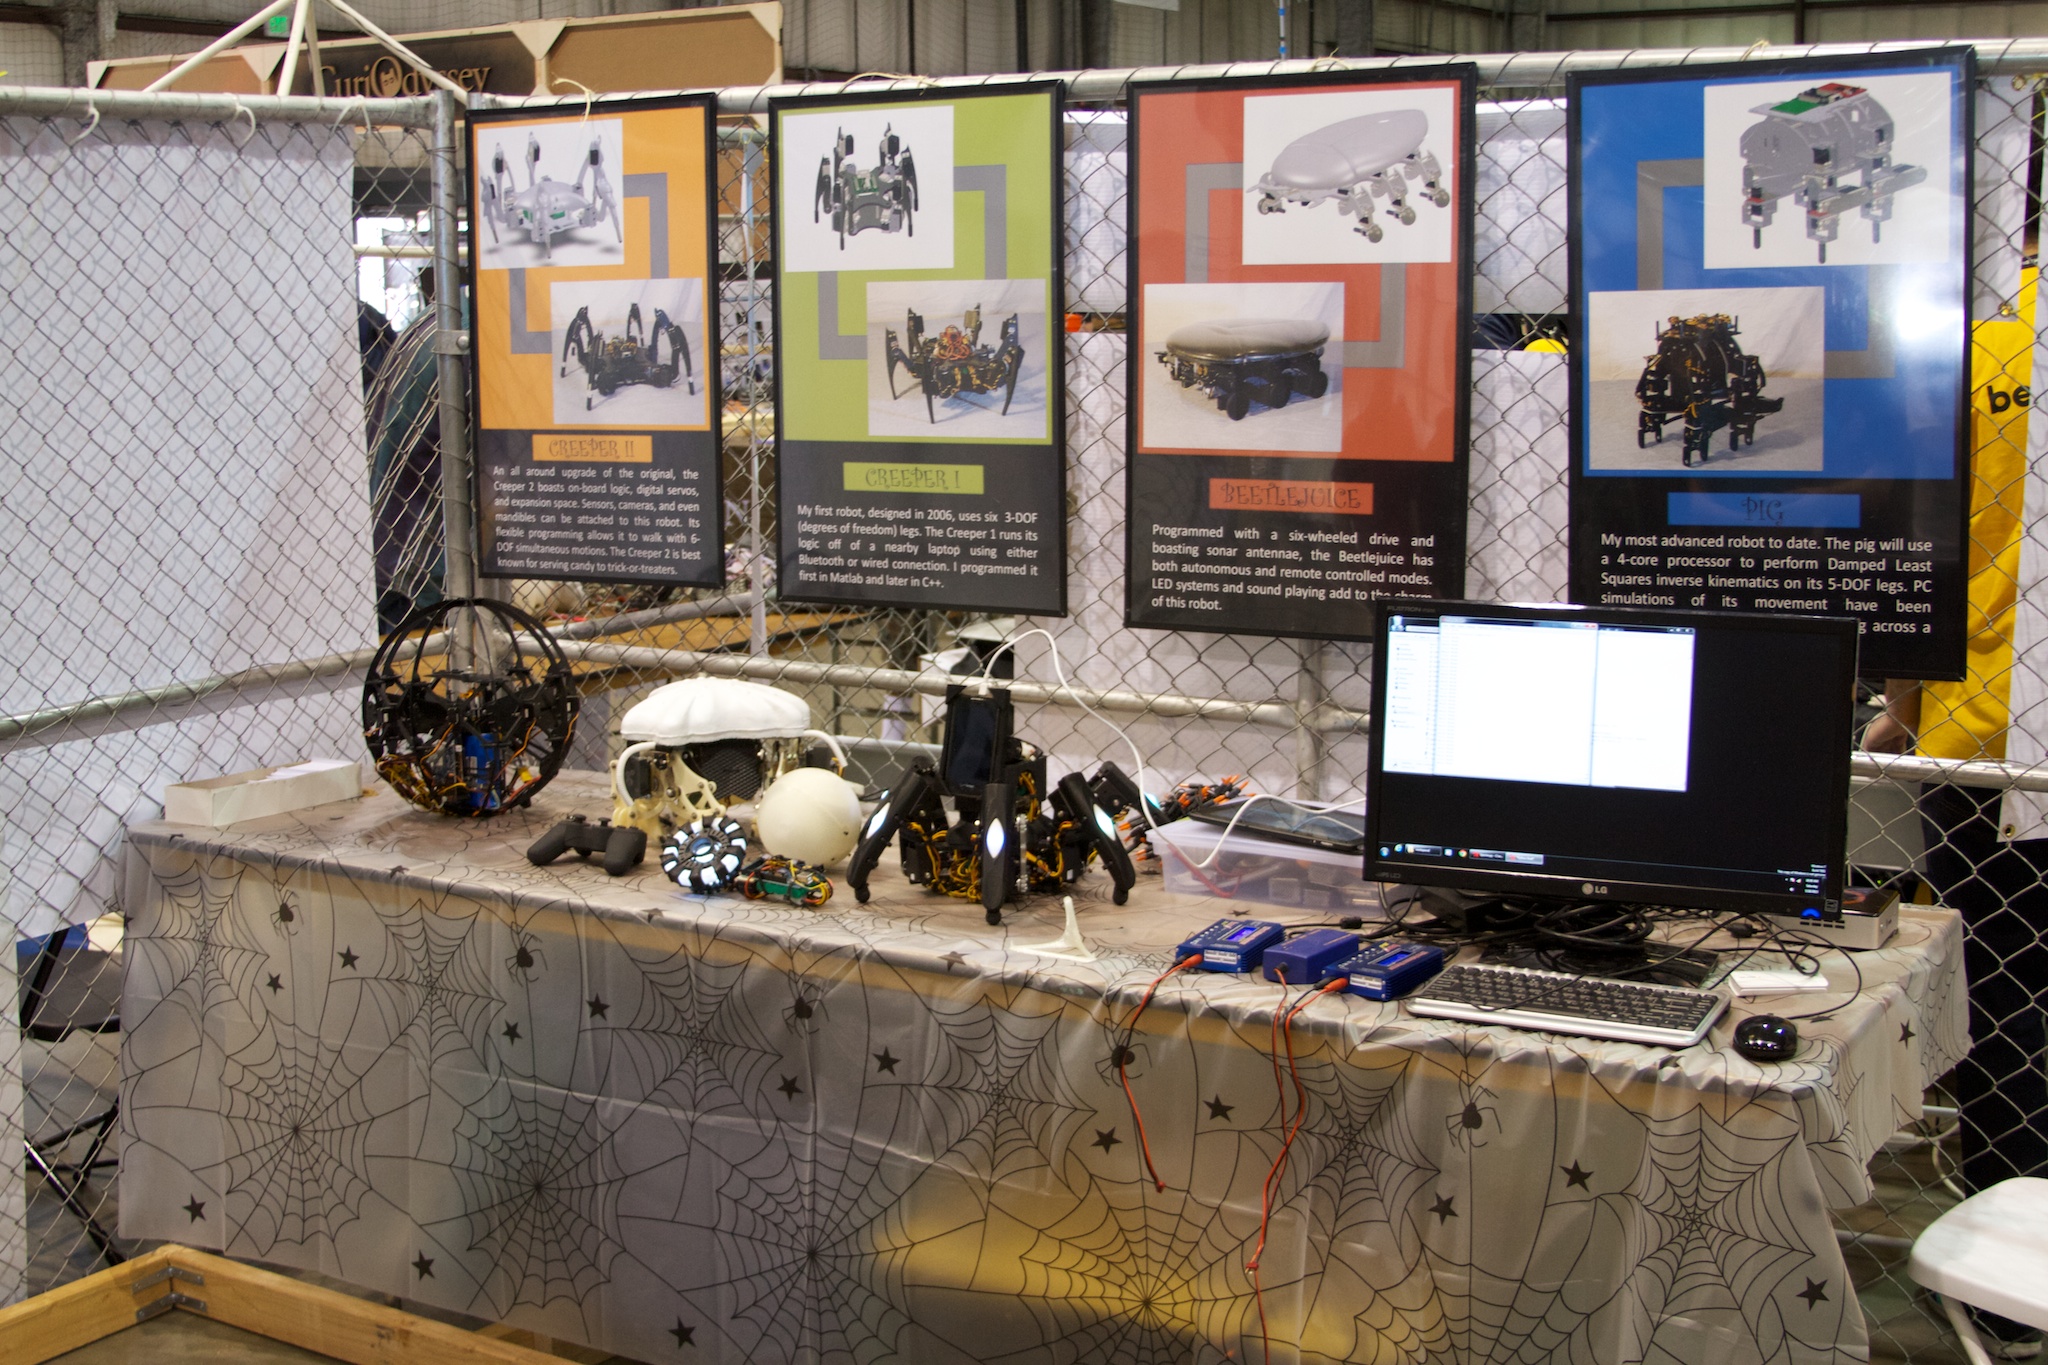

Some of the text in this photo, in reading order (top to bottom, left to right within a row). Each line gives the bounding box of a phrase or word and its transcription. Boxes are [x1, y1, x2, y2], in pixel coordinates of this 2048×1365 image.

[321, 56, 491, 97] uriOdysey
[549, 438, 635, 459] CREEPER II
[492, 465, 699, 481] An all around upgrade of the original, the
[865, 466, 961, 490] CREEPER I
[492, 480, 699, 496] Creeper boasts on-board logic, digital servos,
[1220, 481, 1361, 509] BEETLEJUICE
[493, 495, 700, 511] and expansion space. Sensors, cameras, and even
[1741, 496, 1784, 527] PIG
[494, 511, 701, 528] mandibles can be attached to this robot. Its
[796, 504, 1038, 523] My first robot, designed 2006, uses six 3-DOF
[494, 525, 701, 544] flexible programming allows to walk with 6-
[797, 520, 1038, 541] (degrees of freedom) legs. The Creeper runs its
[1151, 524, 1434, 547] Programmed with six-wheeled drive and
[496, 541, 701, 560] DOF simultaneous motions. The Creeper best
[797, 537, 1038, 559] logic off of nearby laptop using either
[1600, 533, 1933, 553] My most advanced robot to date. The pig will use
[1151, 541, 1434, 566] boasting sonar antennae, the Beetlejuice has
[1616, 553, 1932, 572] 4-core processor to perform Damped Least
[496, 556, 525, 567] known
[525, 557, 538, 568] for
[538, 559, 569, 572] serving
[569, 560, 595, 572] candy
[595, 562, 606, 571] to
[798, 553, 1027, 575] Bluetooth or wired connection. programmed
[1151, 559, 1432, 585] both autonomous and remote controlled modes.
[798, 569, 944, 588] first Matlab and later C++.
[1151, 577, 1368, 600] LED systems and sound playing add to
[1600, 572, 1932, 594] Squares inverse kinematics on its 5-DOF legs. PC
[1150, 594, 1222, 610] of this robot.
[1600, 591, 1931, 613] simulations of its movement have been
[1871, 622, 1917, 633] across
[1595, 885, 1608, 895] LG
